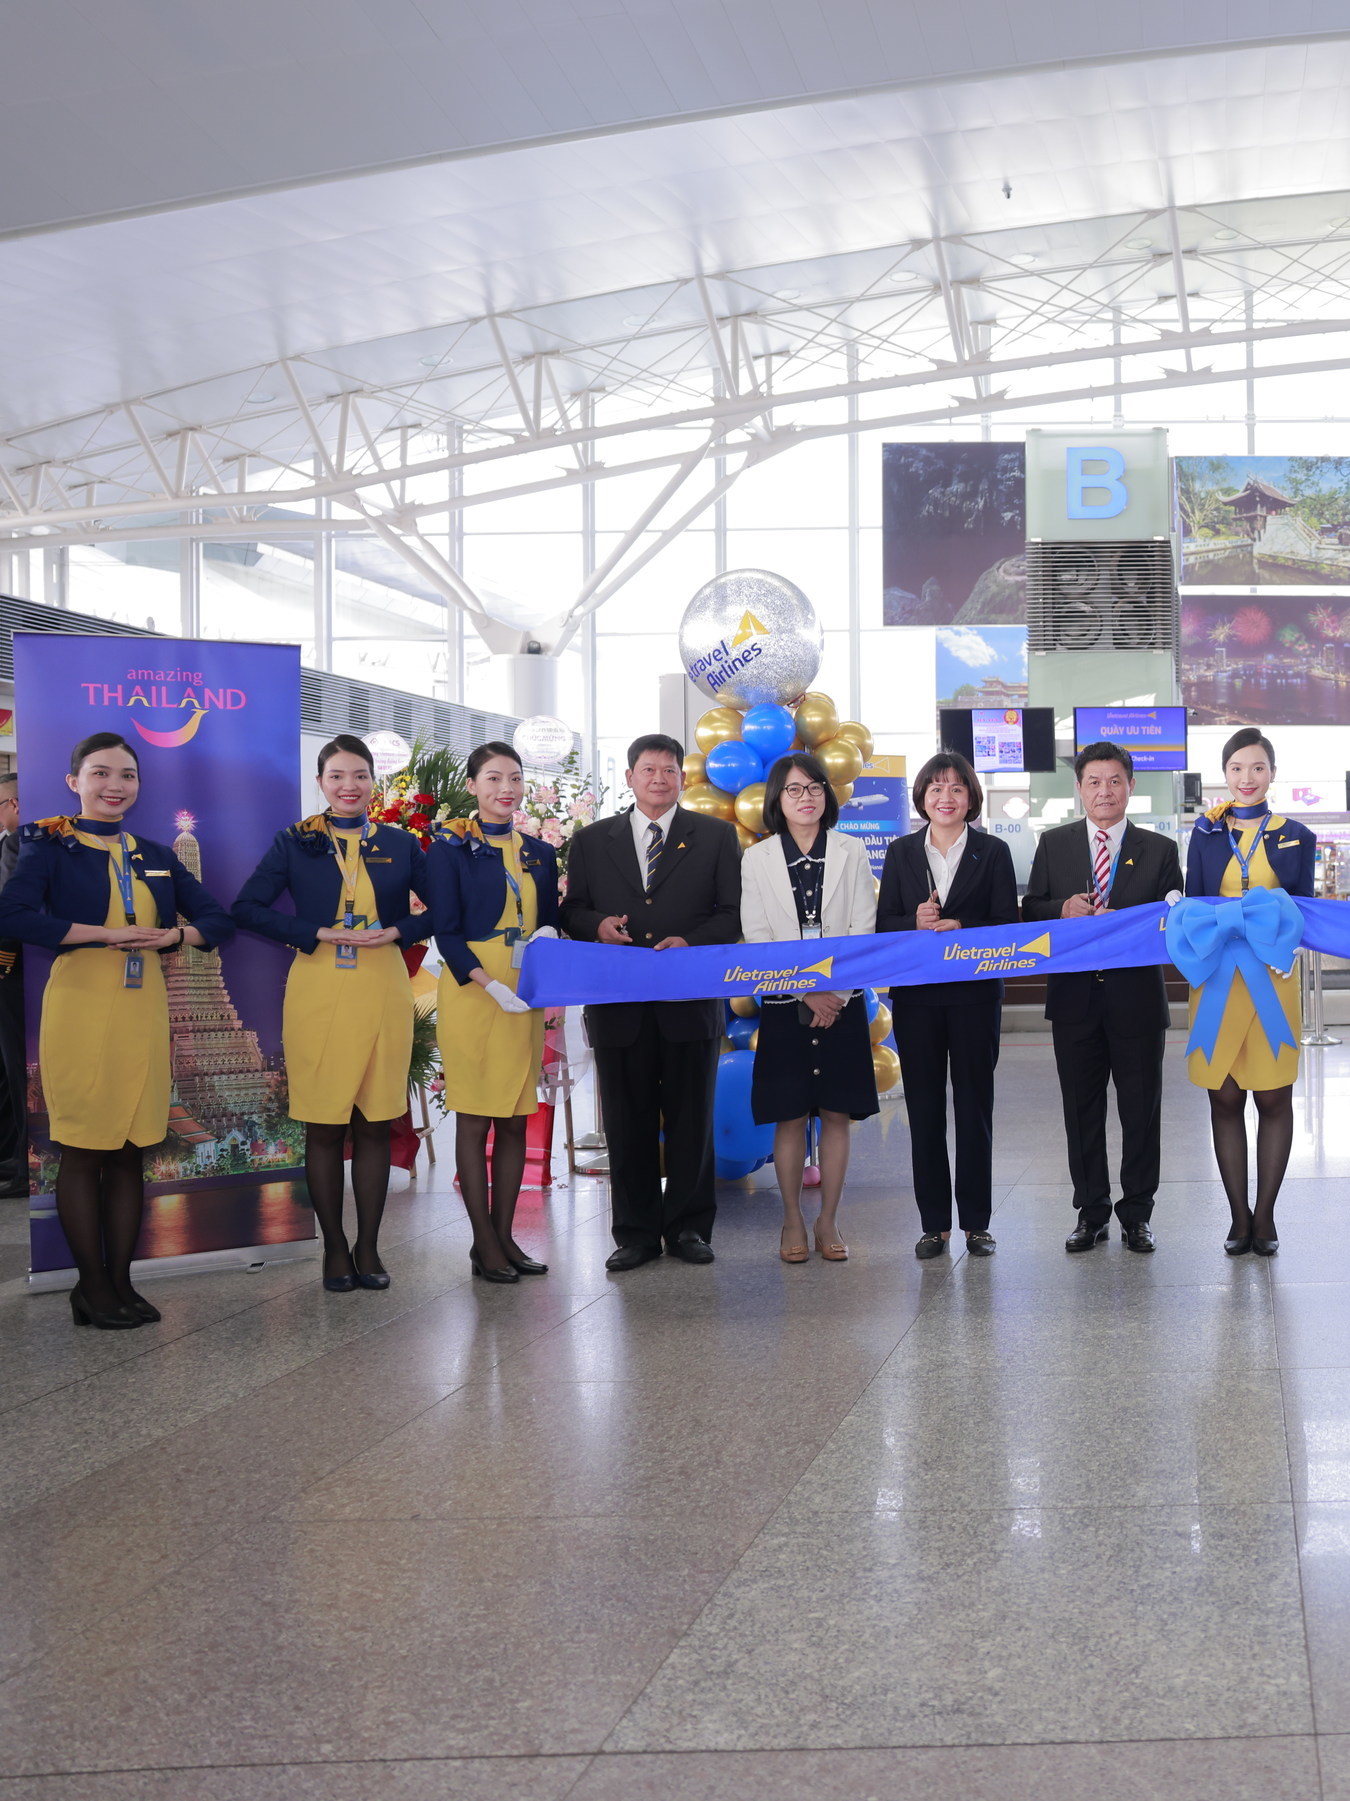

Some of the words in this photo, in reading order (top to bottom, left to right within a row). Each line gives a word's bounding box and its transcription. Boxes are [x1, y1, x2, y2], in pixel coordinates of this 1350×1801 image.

[1066, 446, 1128, 520] B
[706, 642, 763, 693] Airlines
[127, 667, 204, 686] amazing
[81, 683, 247, 710] THAILAND
[1100, 724, 1124, 737] QUẦY
[1126, 725, 1140, 735] ƯU
[1141, 724, 1162, 735] TIÊN
[995, 824, 1021, 833] B-00
[943, 942, 1016, 960] Vietravel
[723, 965, 799, 982] Vietravel
[974, 958, 1036, 974] Airlines
[752, 979, 817, 994] Airlines
